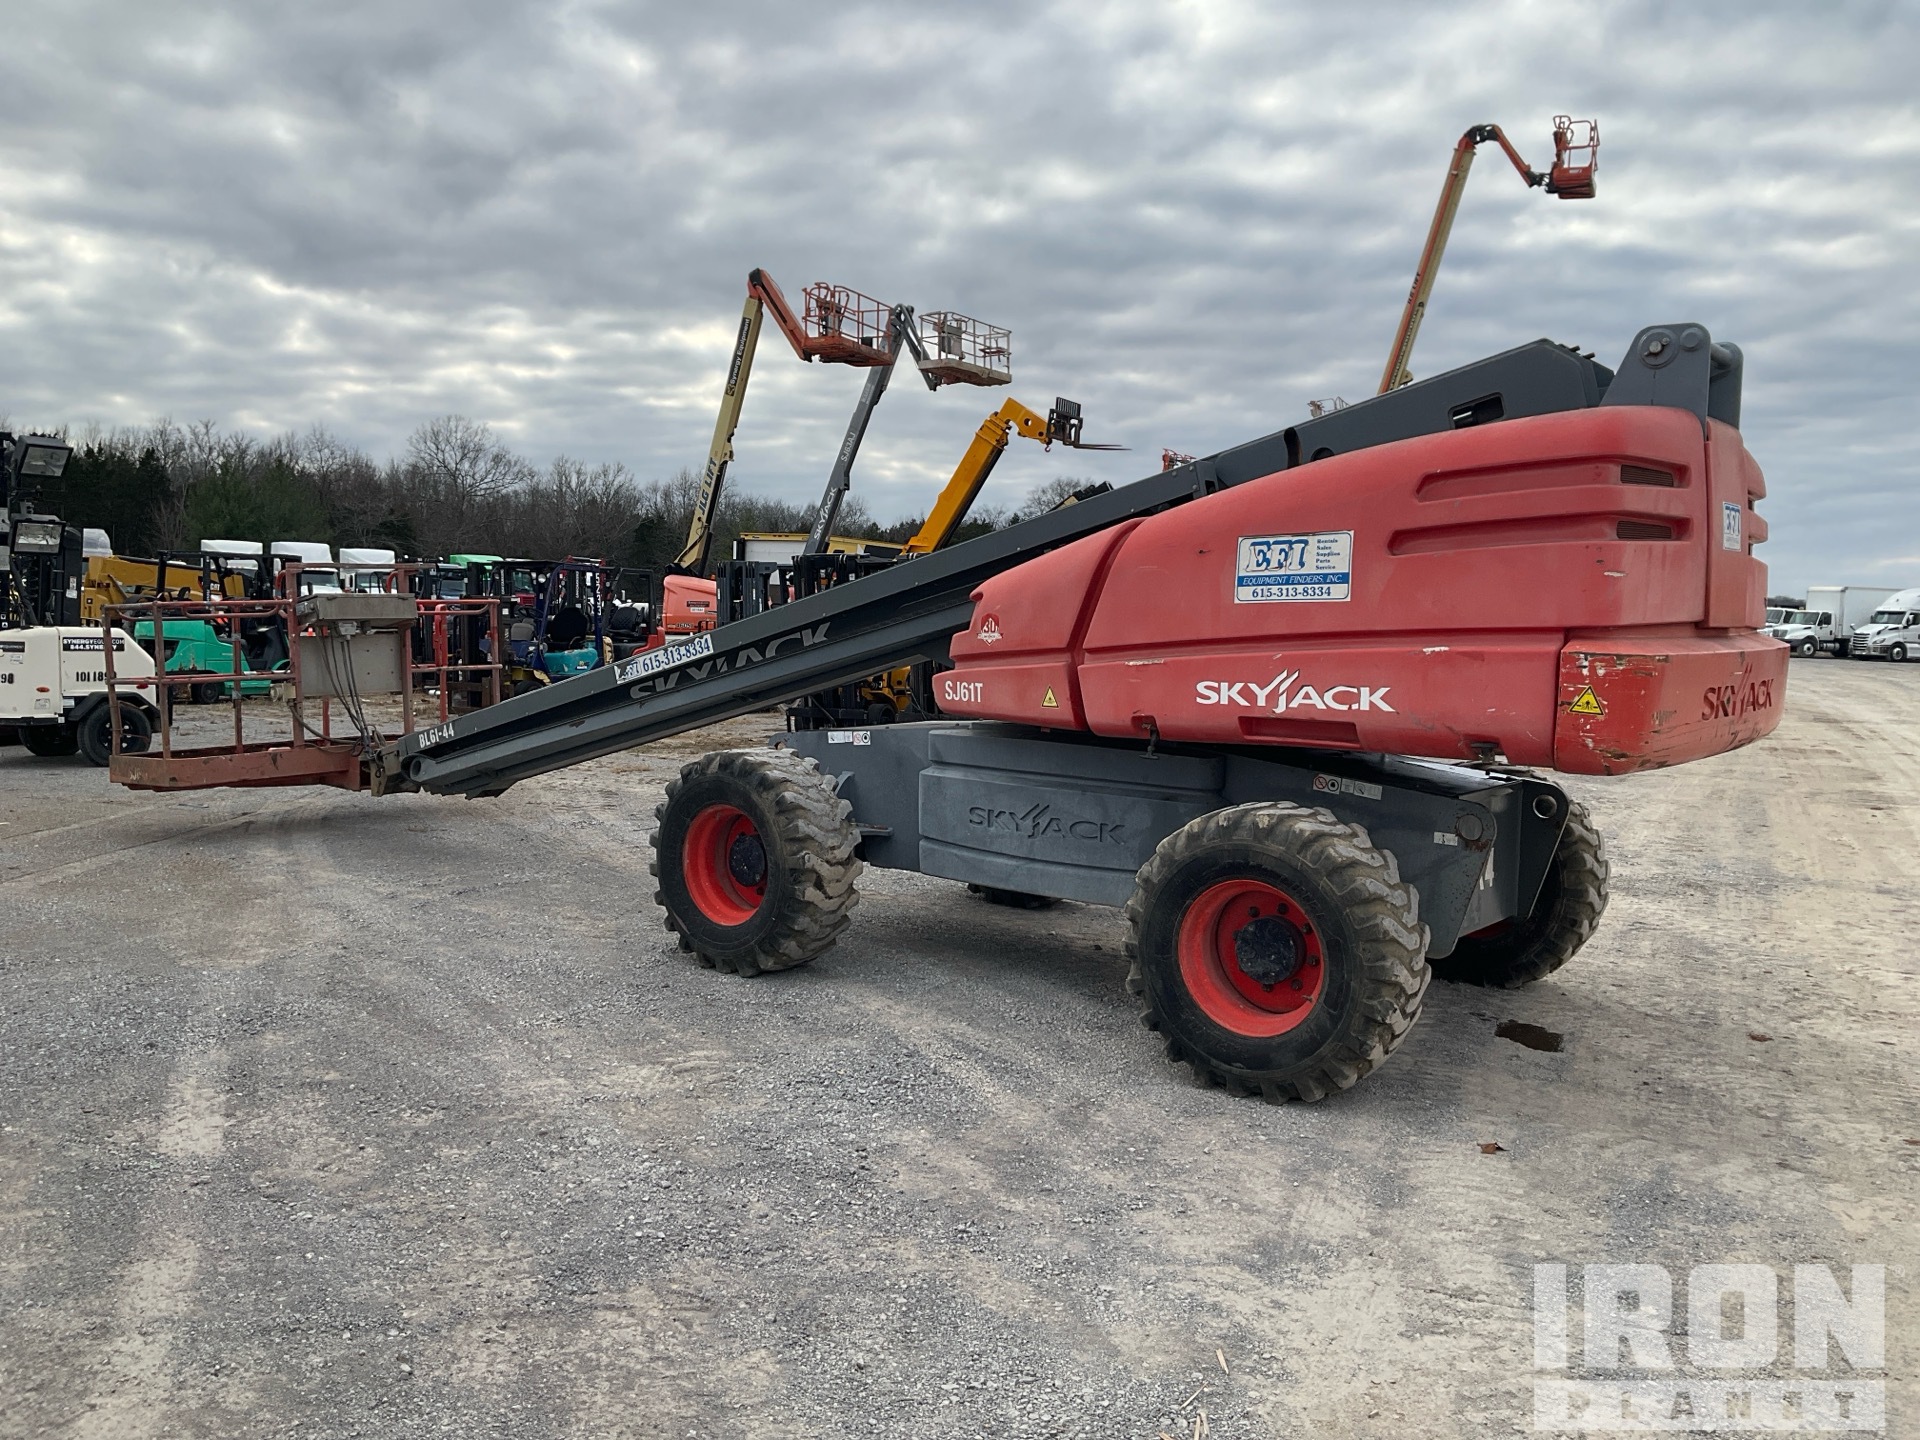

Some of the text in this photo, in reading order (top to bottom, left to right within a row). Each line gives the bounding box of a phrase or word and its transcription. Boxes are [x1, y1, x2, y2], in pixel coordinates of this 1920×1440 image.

[730, 319, 751, 385] Synergy Equipment
[841, 432, 856, 462] SJ63AJ
[699, 457, 717, 516] JLG LIFT
[813, 487, 837, 540] SKYJACK
[1245, 539, 1309, 572] EFI
[1243, 576, 1287, 586] EQUIPMENT
[1252, 586, 1331, 598] 615-313-8334
[642, 637, 711, 672] 615-313-8334
[945, 681, 983, 702] SJ61T
[1196, 669, 1397, 714] SKYJACK
[1702, 662, 1774, 722] SKYJACK
[419, 722, 454, 749] BL61-44
[969, 803, 1126, 846] SKYJACK
